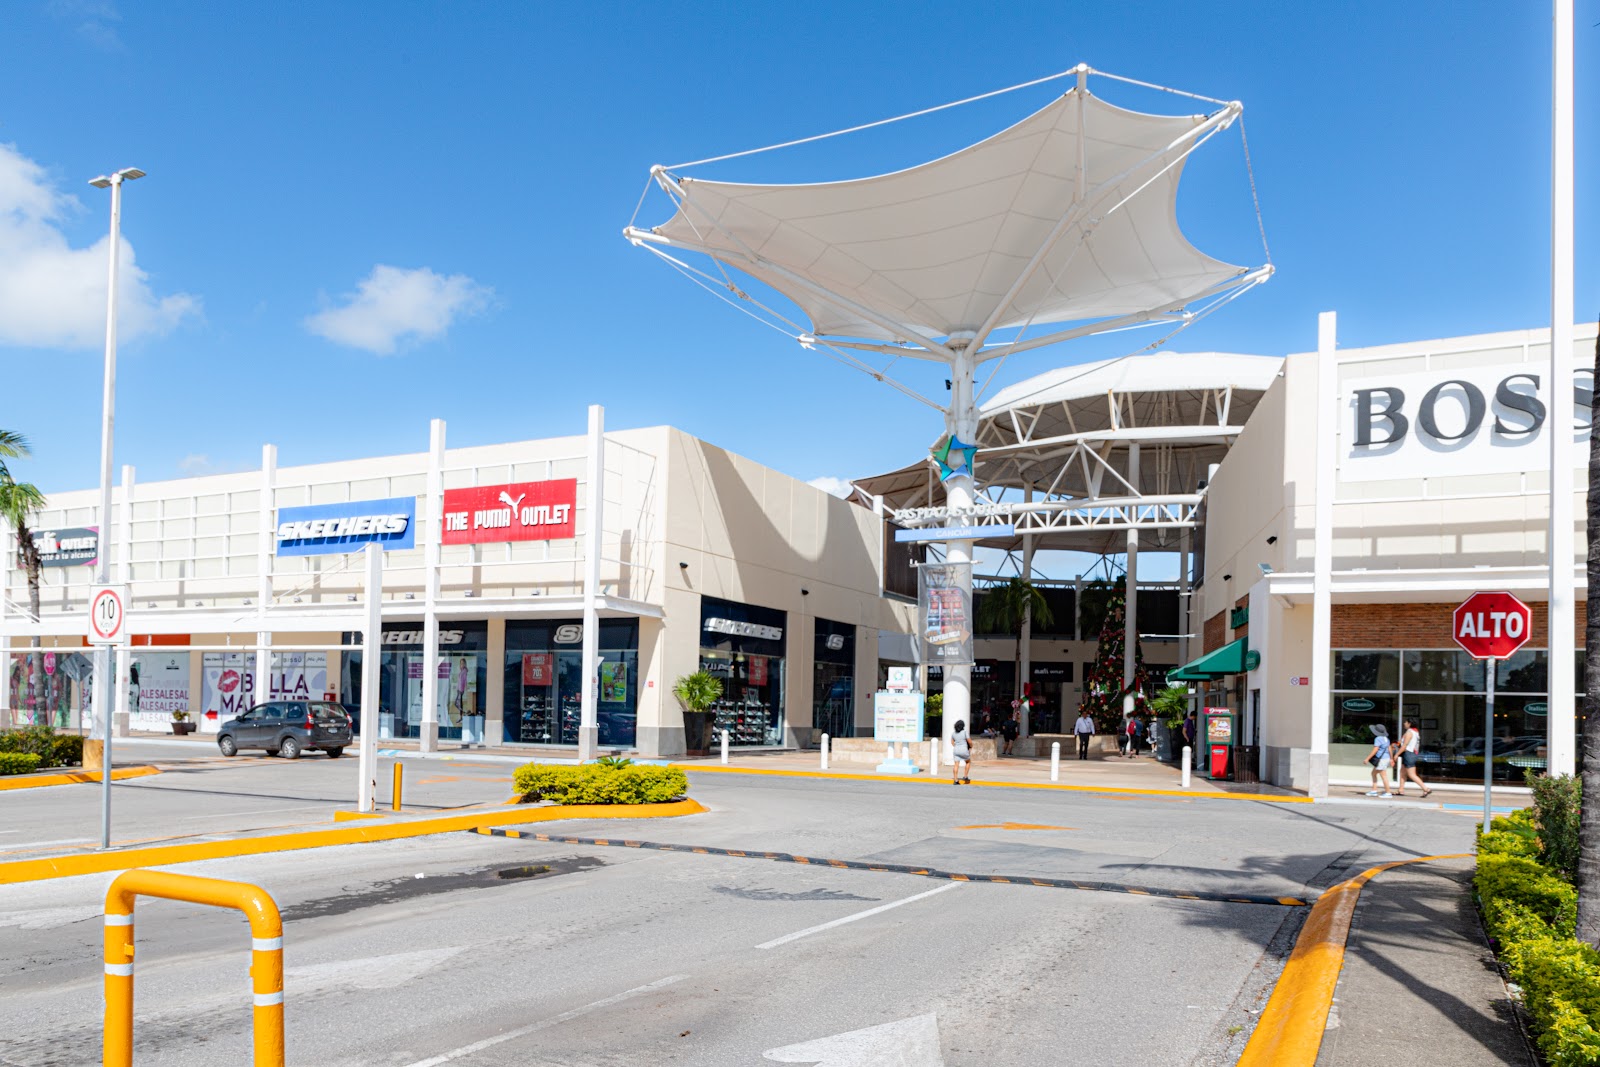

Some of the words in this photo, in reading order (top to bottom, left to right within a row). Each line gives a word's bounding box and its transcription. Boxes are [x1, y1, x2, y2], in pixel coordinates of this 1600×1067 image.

[445, 511, 468, 531] THE
[474, 508, 511, 530] PUMA
[521, 503, 570, 527] OUTLET
[917, 506, 963, 519] PLAZAS
[965, 502, 1013, 516] OUTLET
[277, 513, 411, 541] SKECHERS
[60, 537, 97, 550] OUTLET
[61, 552, 69, 560] tu
[70, 550, 96, 559] alcance
[100, 599, 115, 619] 10
[1459, 611, 1524, 638] ALTO
[240, 672, 310, 694] BLLA
